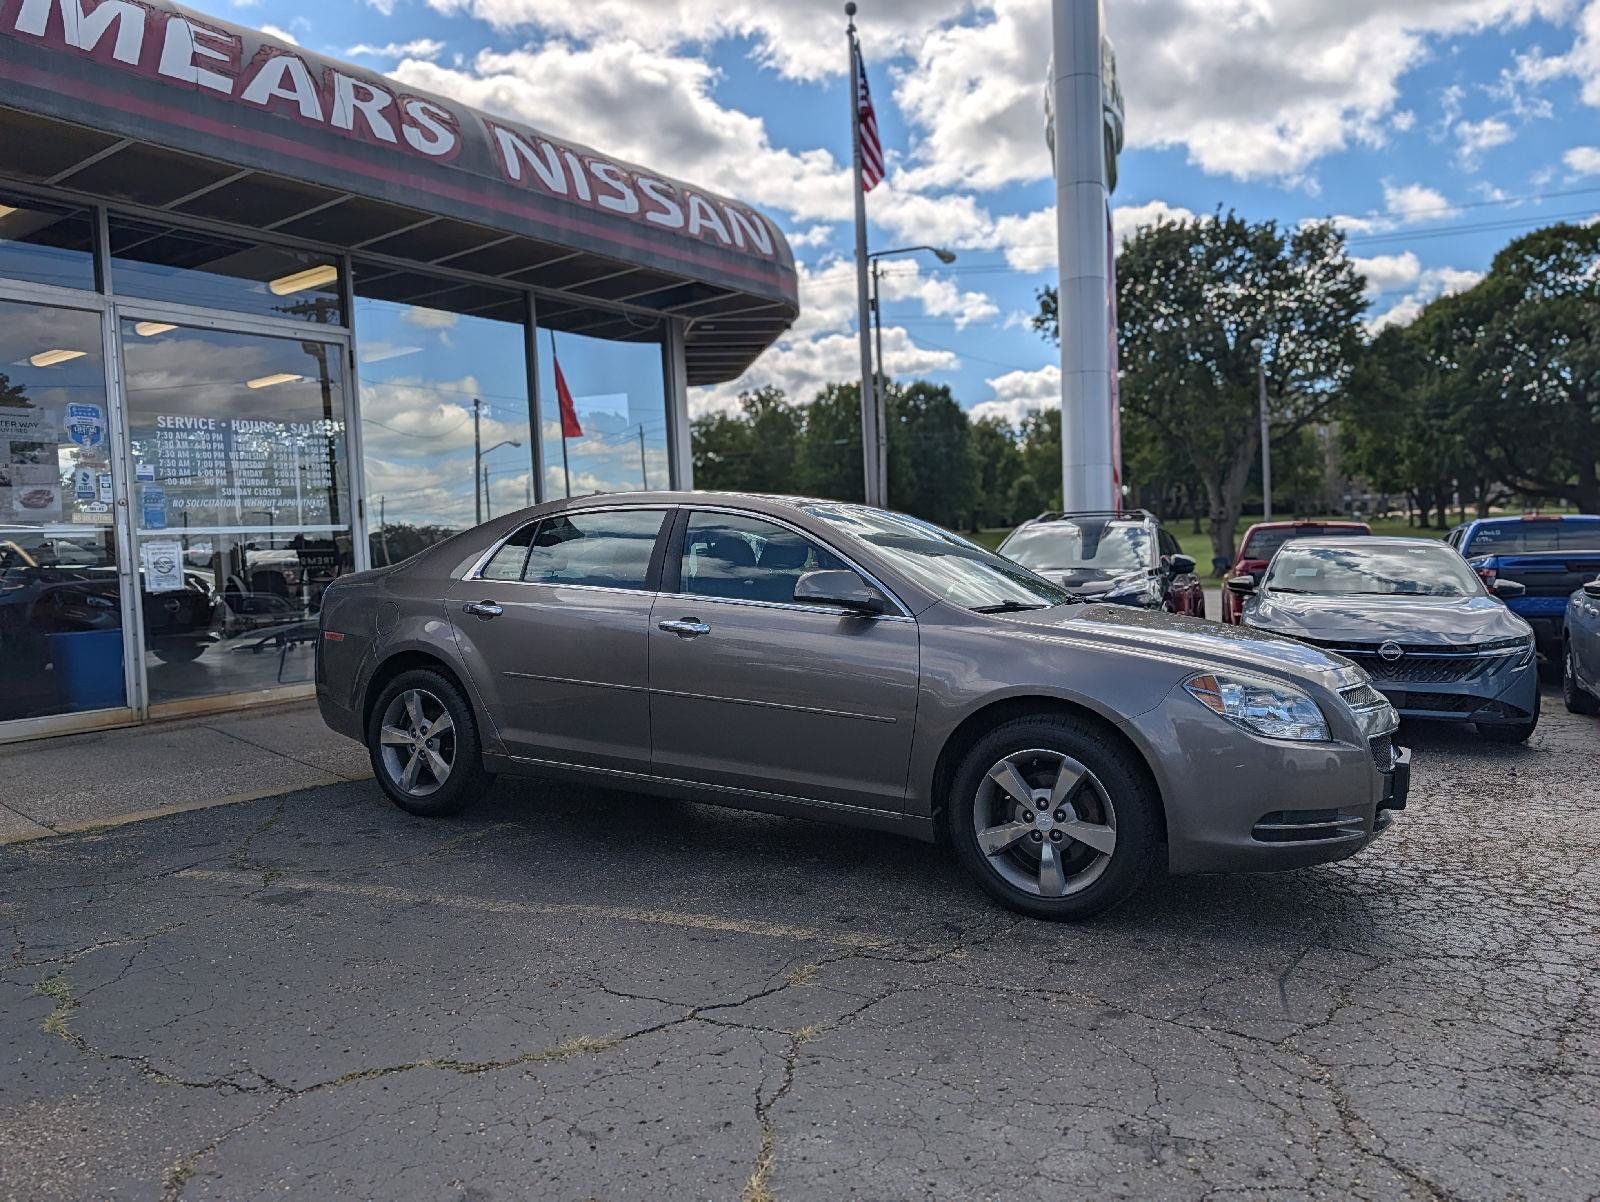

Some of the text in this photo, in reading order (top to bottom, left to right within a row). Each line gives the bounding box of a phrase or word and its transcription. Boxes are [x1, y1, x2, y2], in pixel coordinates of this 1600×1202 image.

[14, 0, 774, 256] MEARS NISSAN
[157, 415, 216, 430] SERVICE
[231, 419, 276, 432] HOURS
[156, 431, 173, 440] 7:30
[175, 431, 188, 440] AM
[211, 432, 223, 441] PM
[157, 440, 174, 449] 7:30
[176, 440, 189, 449] AM
[212, 442, 225, 450] PM
[158, 450, 175, 458] 7:30
[177, 451, 190, 459] AM
[213, 452, 225, 460] PM
[159, 459, 177, 467] 7:30
[179, 459, 191, 467] AM
[214, 460, 226, 468] PM
[160, 468, 177, 476] 7:30
[180, 468, 191, 476] AM
[215, 469, 227, 477] PM
[239, 470, 263, 478] FRIDAY
[180, 478, 192, 486] AM
[215, 478, 227, 486] PM
[221, 488, 282, 496] SUNDAY CLOSED
[173, 499, 184, 508] NO
